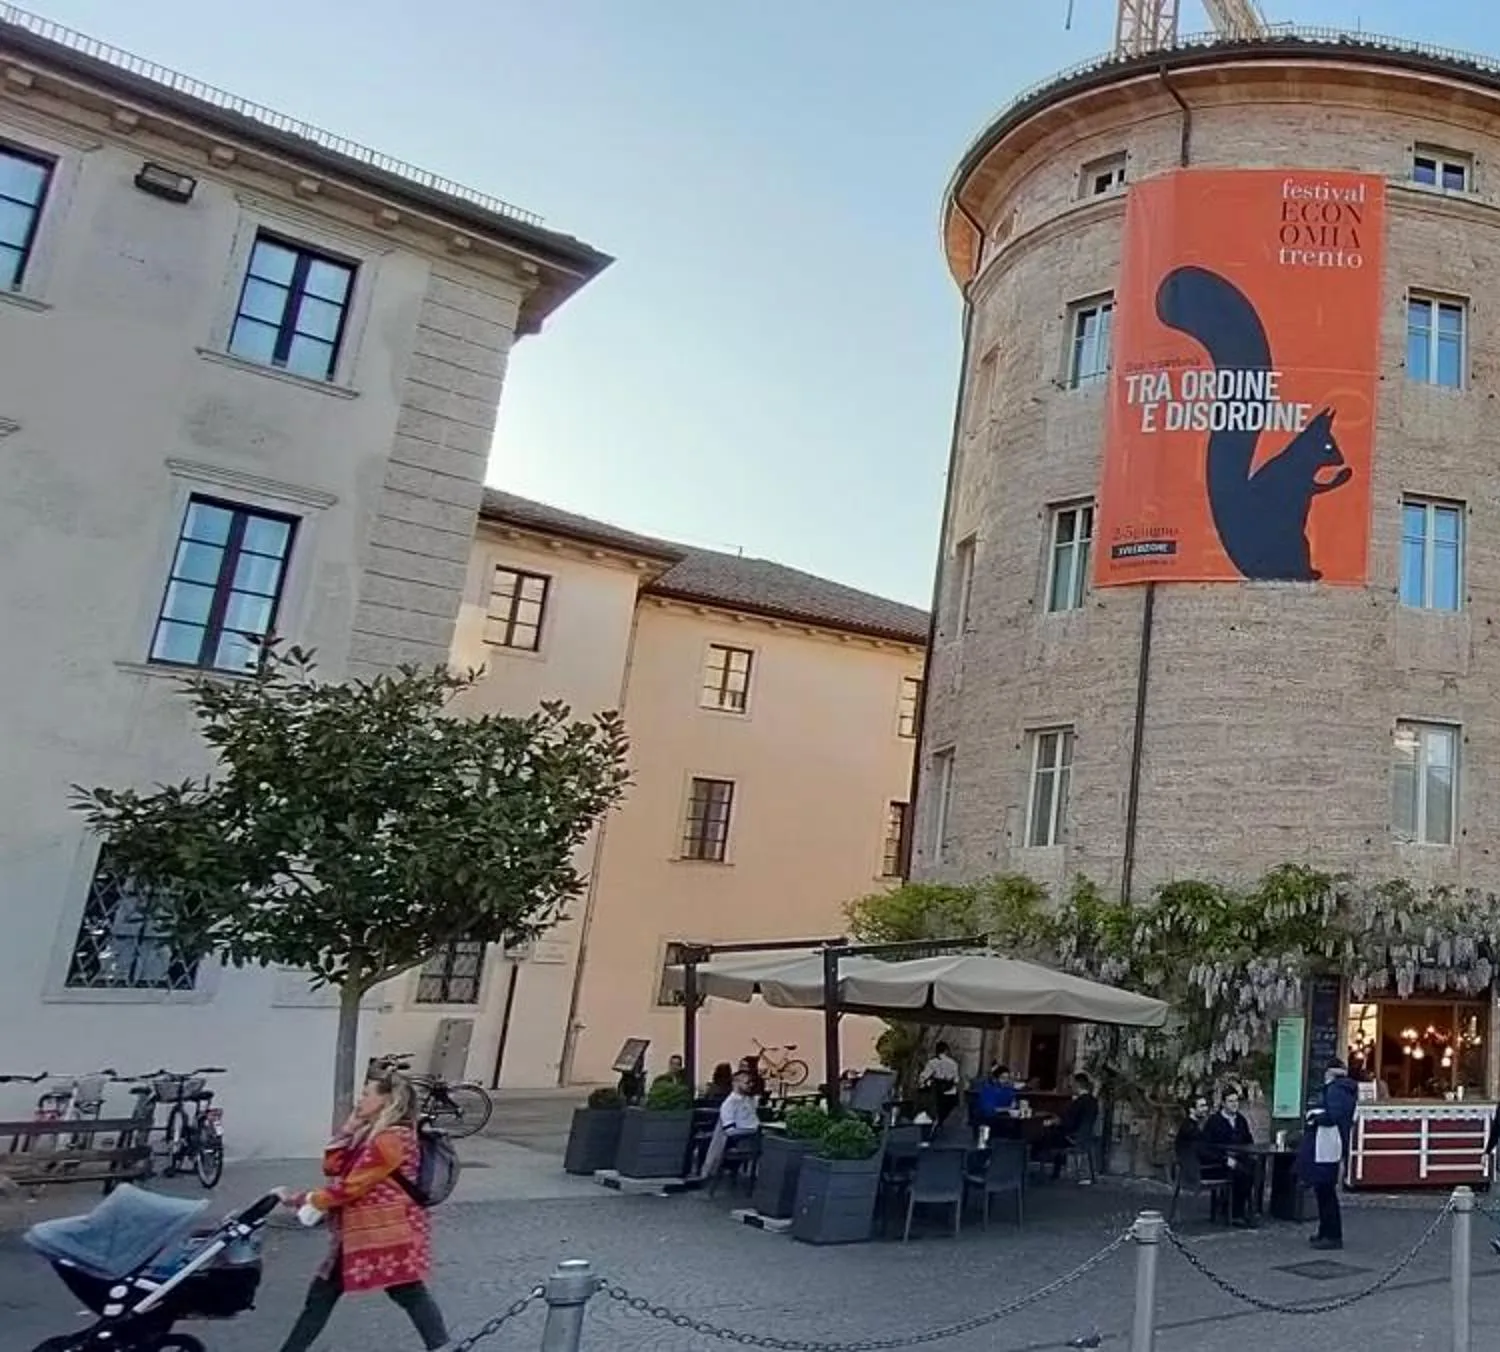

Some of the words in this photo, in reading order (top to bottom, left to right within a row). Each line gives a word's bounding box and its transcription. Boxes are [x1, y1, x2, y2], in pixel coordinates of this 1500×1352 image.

[1283, 179, 1365, 203] festival
[1281, 201, 1362, 224] ECON
[1279, 224, 1361, 249] OMIA
[1279, 247, 1363, 268] trento
[1124, 371, 1173, 404] TRA
[1181, 369, 1283, 401] ORDINE
[1140, 403, 1160, 433] E
[1164, 401, 1313, 433] DISORDINE
